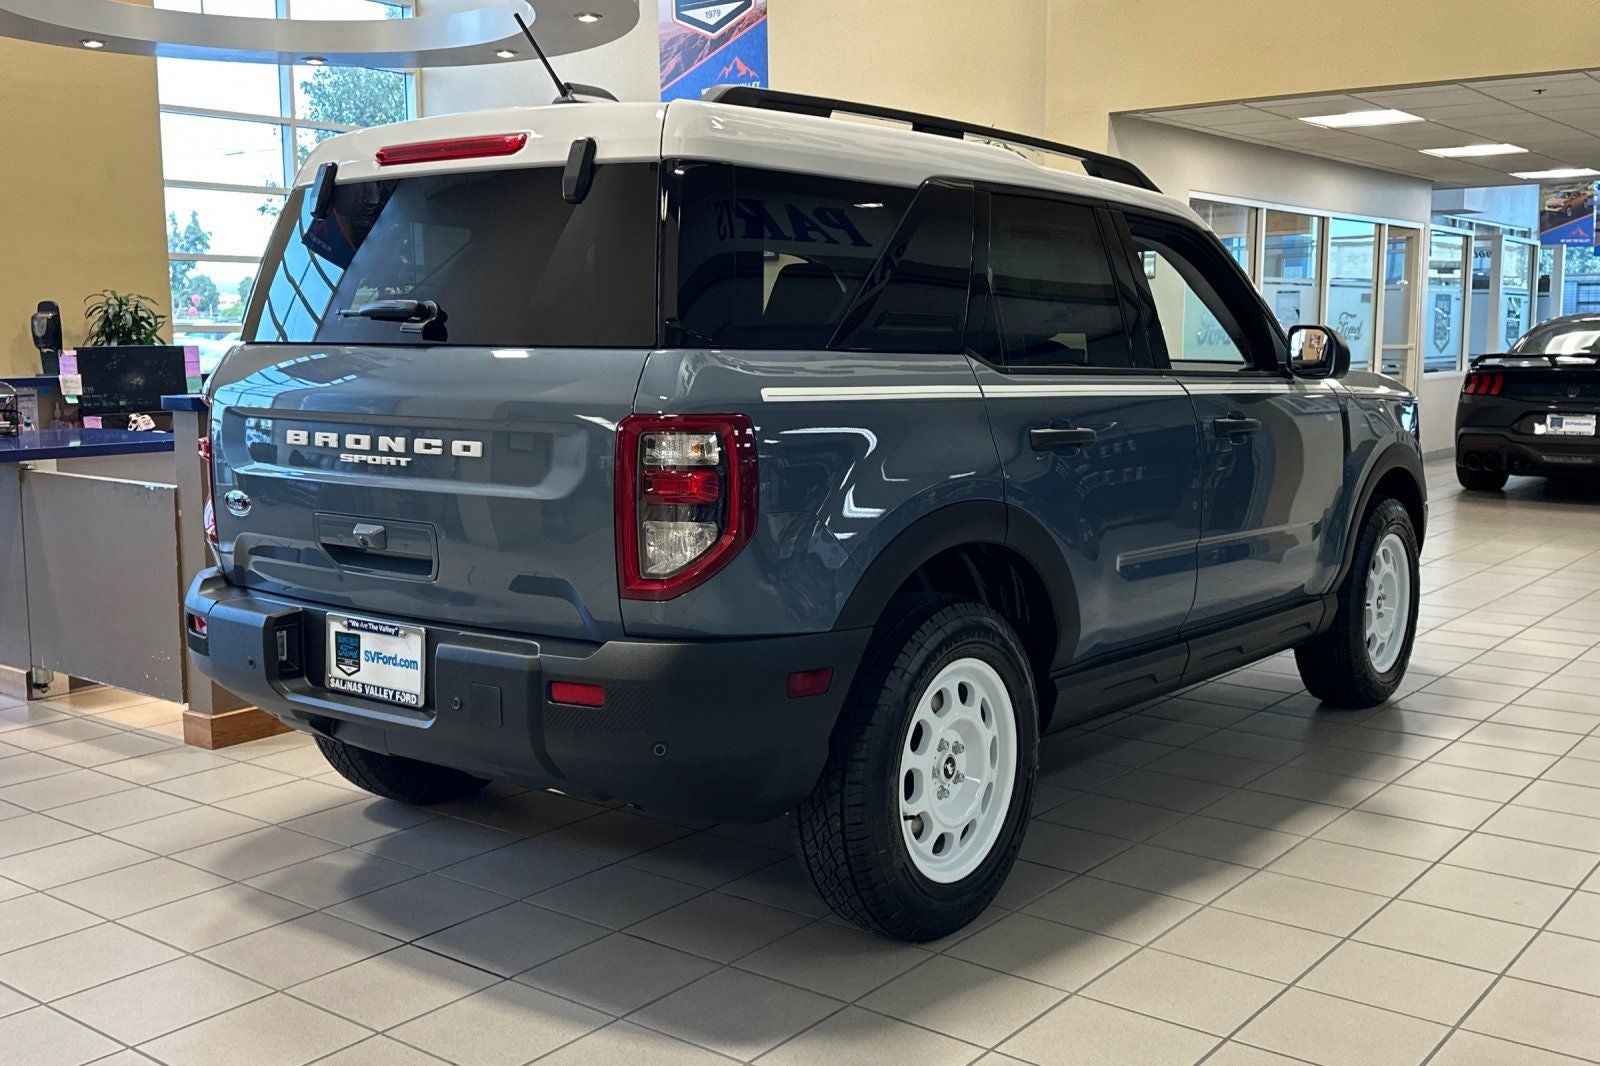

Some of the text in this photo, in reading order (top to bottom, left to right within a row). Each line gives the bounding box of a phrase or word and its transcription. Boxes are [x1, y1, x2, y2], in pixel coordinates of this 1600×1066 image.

[705, 9, 721, 19] 1979
[286, 429, 483, 458] BRONCO
[339, 453, 412, 467] SPORT
[368, 622, 378, 631] The
[364, 650, 419, 671] SVFord.com
[329, 677, 418, 705] SALINAS VALLEY FORD
